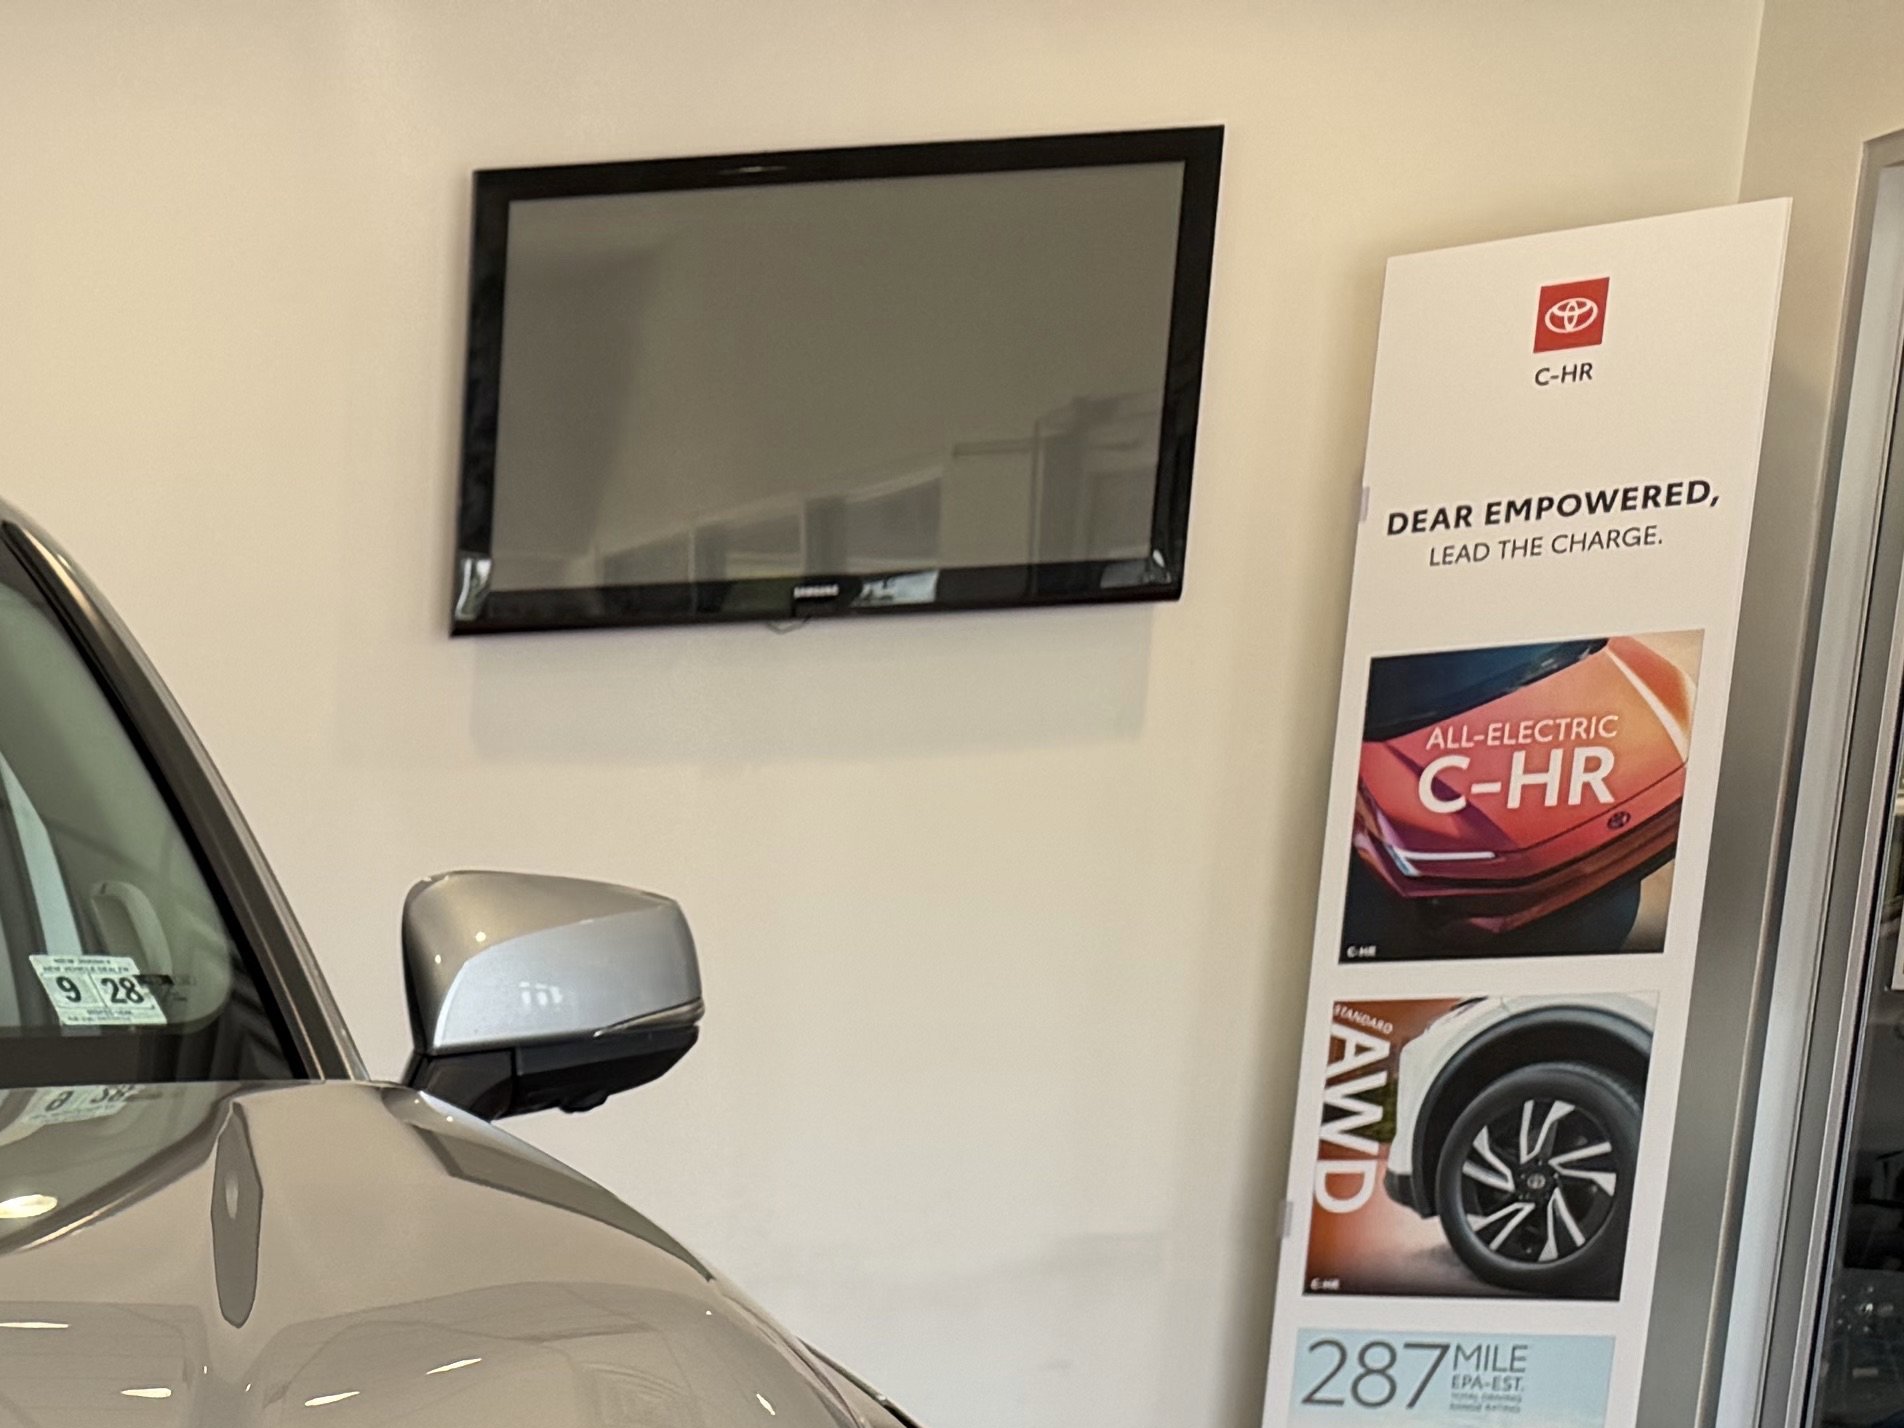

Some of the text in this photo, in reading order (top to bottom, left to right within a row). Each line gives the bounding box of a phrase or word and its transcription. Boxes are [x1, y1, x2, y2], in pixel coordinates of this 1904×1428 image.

[1534, 362, 1593, 386] C-HR
[1387, 479, 1720, 536] DEAR EMPOWERED,
[1429, 525, 1663, 567] LEAD THE CHARGE.
[1426, 715, 1619, 750] ALL-ELECTRIC
[1418, 746, 1616, 814] C-HR
[55, 976, 145, 1004] 9 28
[1333, 1003, 1393, 1034] STANDARD
[1314, 1023, 1391, 1214] AWD
[1301, 1338, 1529, 1410] 287 MILE
[1451, 1374, 1525, 1393] EPA-EST.
